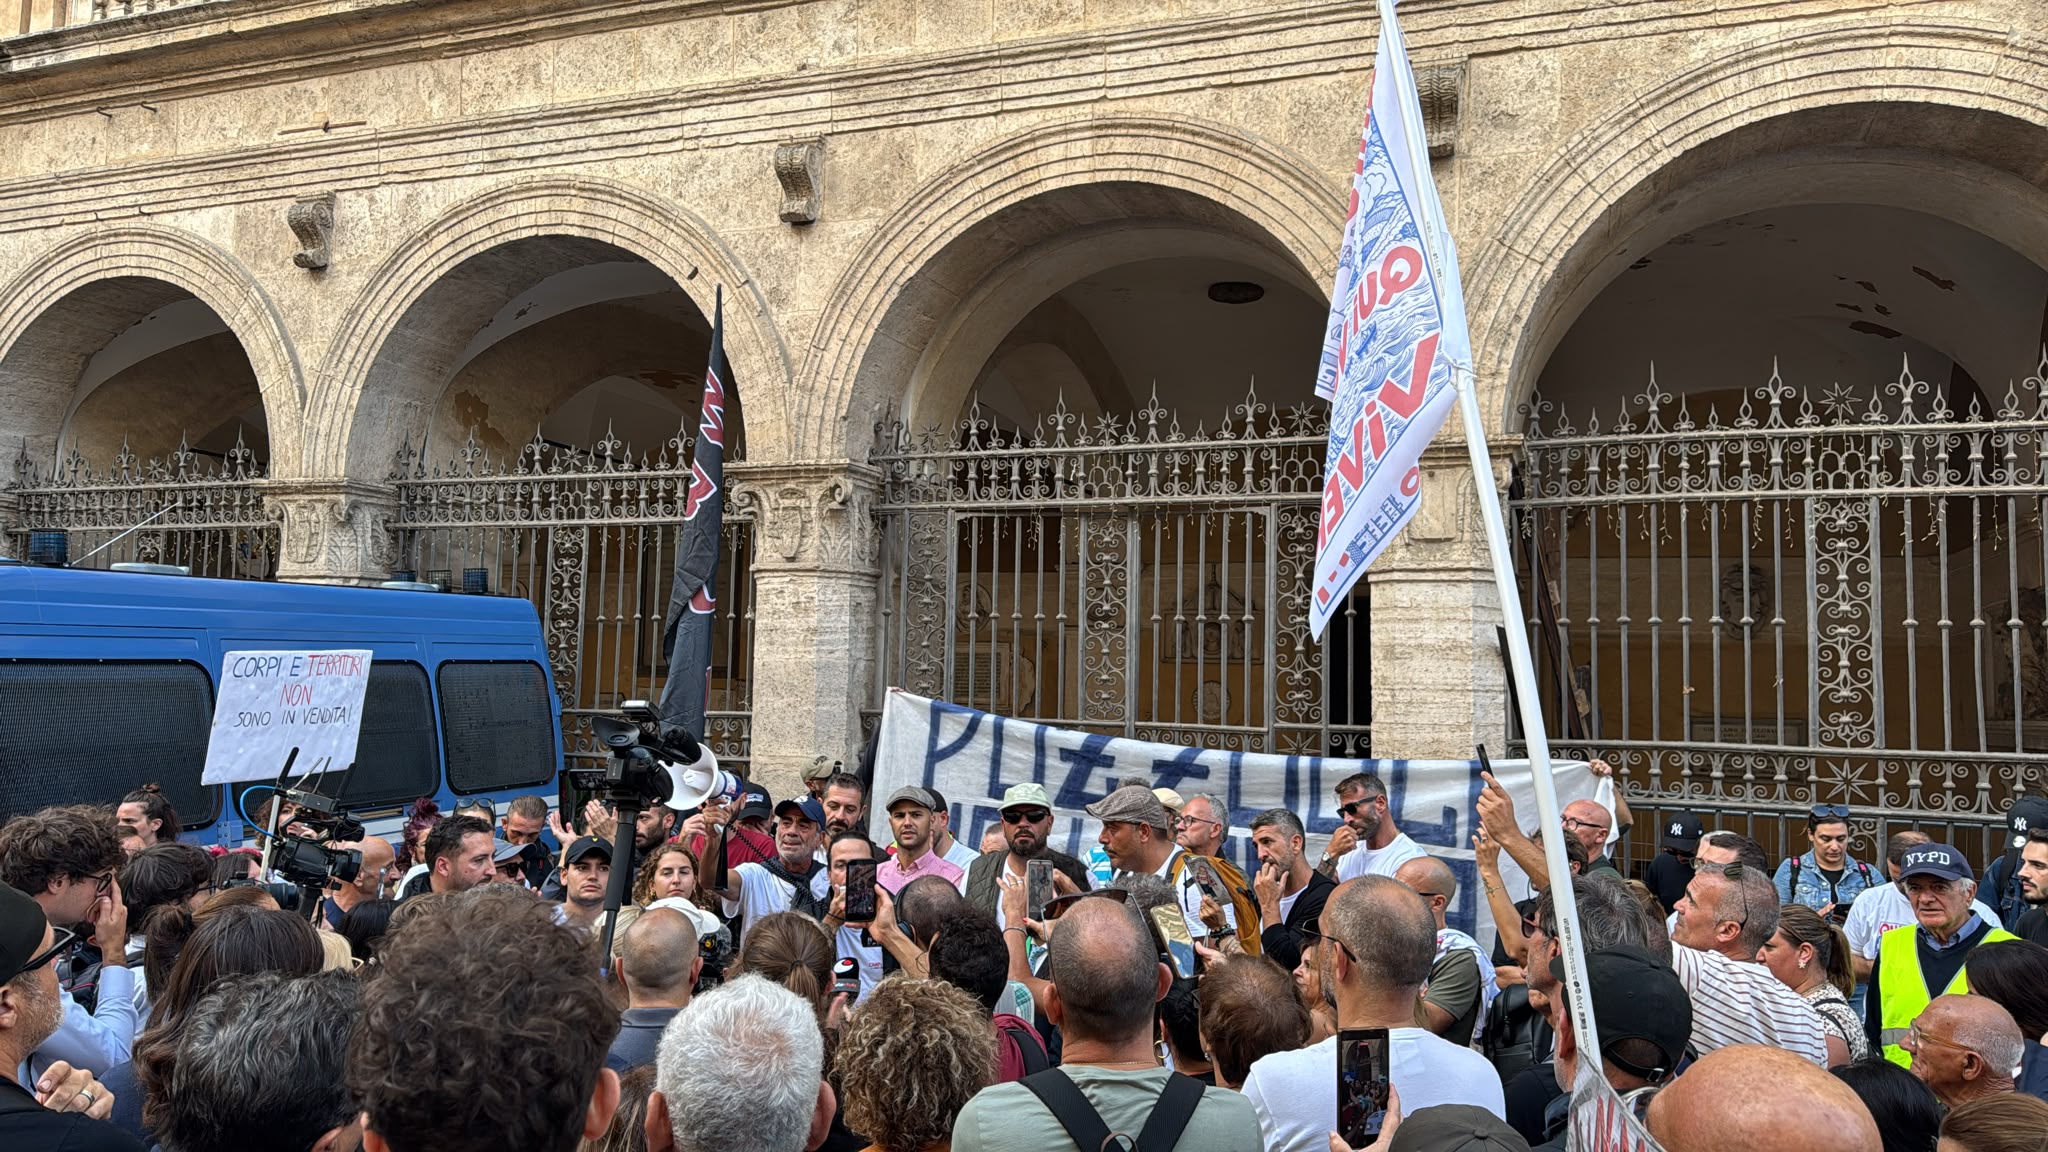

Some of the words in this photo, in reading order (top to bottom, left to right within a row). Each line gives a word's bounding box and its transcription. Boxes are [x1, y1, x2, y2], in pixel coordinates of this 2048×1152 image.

[232, 656, 282, 678] CORPI
[290, 656, 303, 677] E
[308, 654, 363, 677] TERRITORI
[280, 684, 313, 707] NON
[233, 711, 271, 728] SONO
[282, 710, 296, 725] IN
[303, 704, 352, 727] VENDITA!
[1670, 822, 1684, 836] NY
[2014, 816, 2027, 831] NY
[1906, 851, 1950, 867] NYPD
